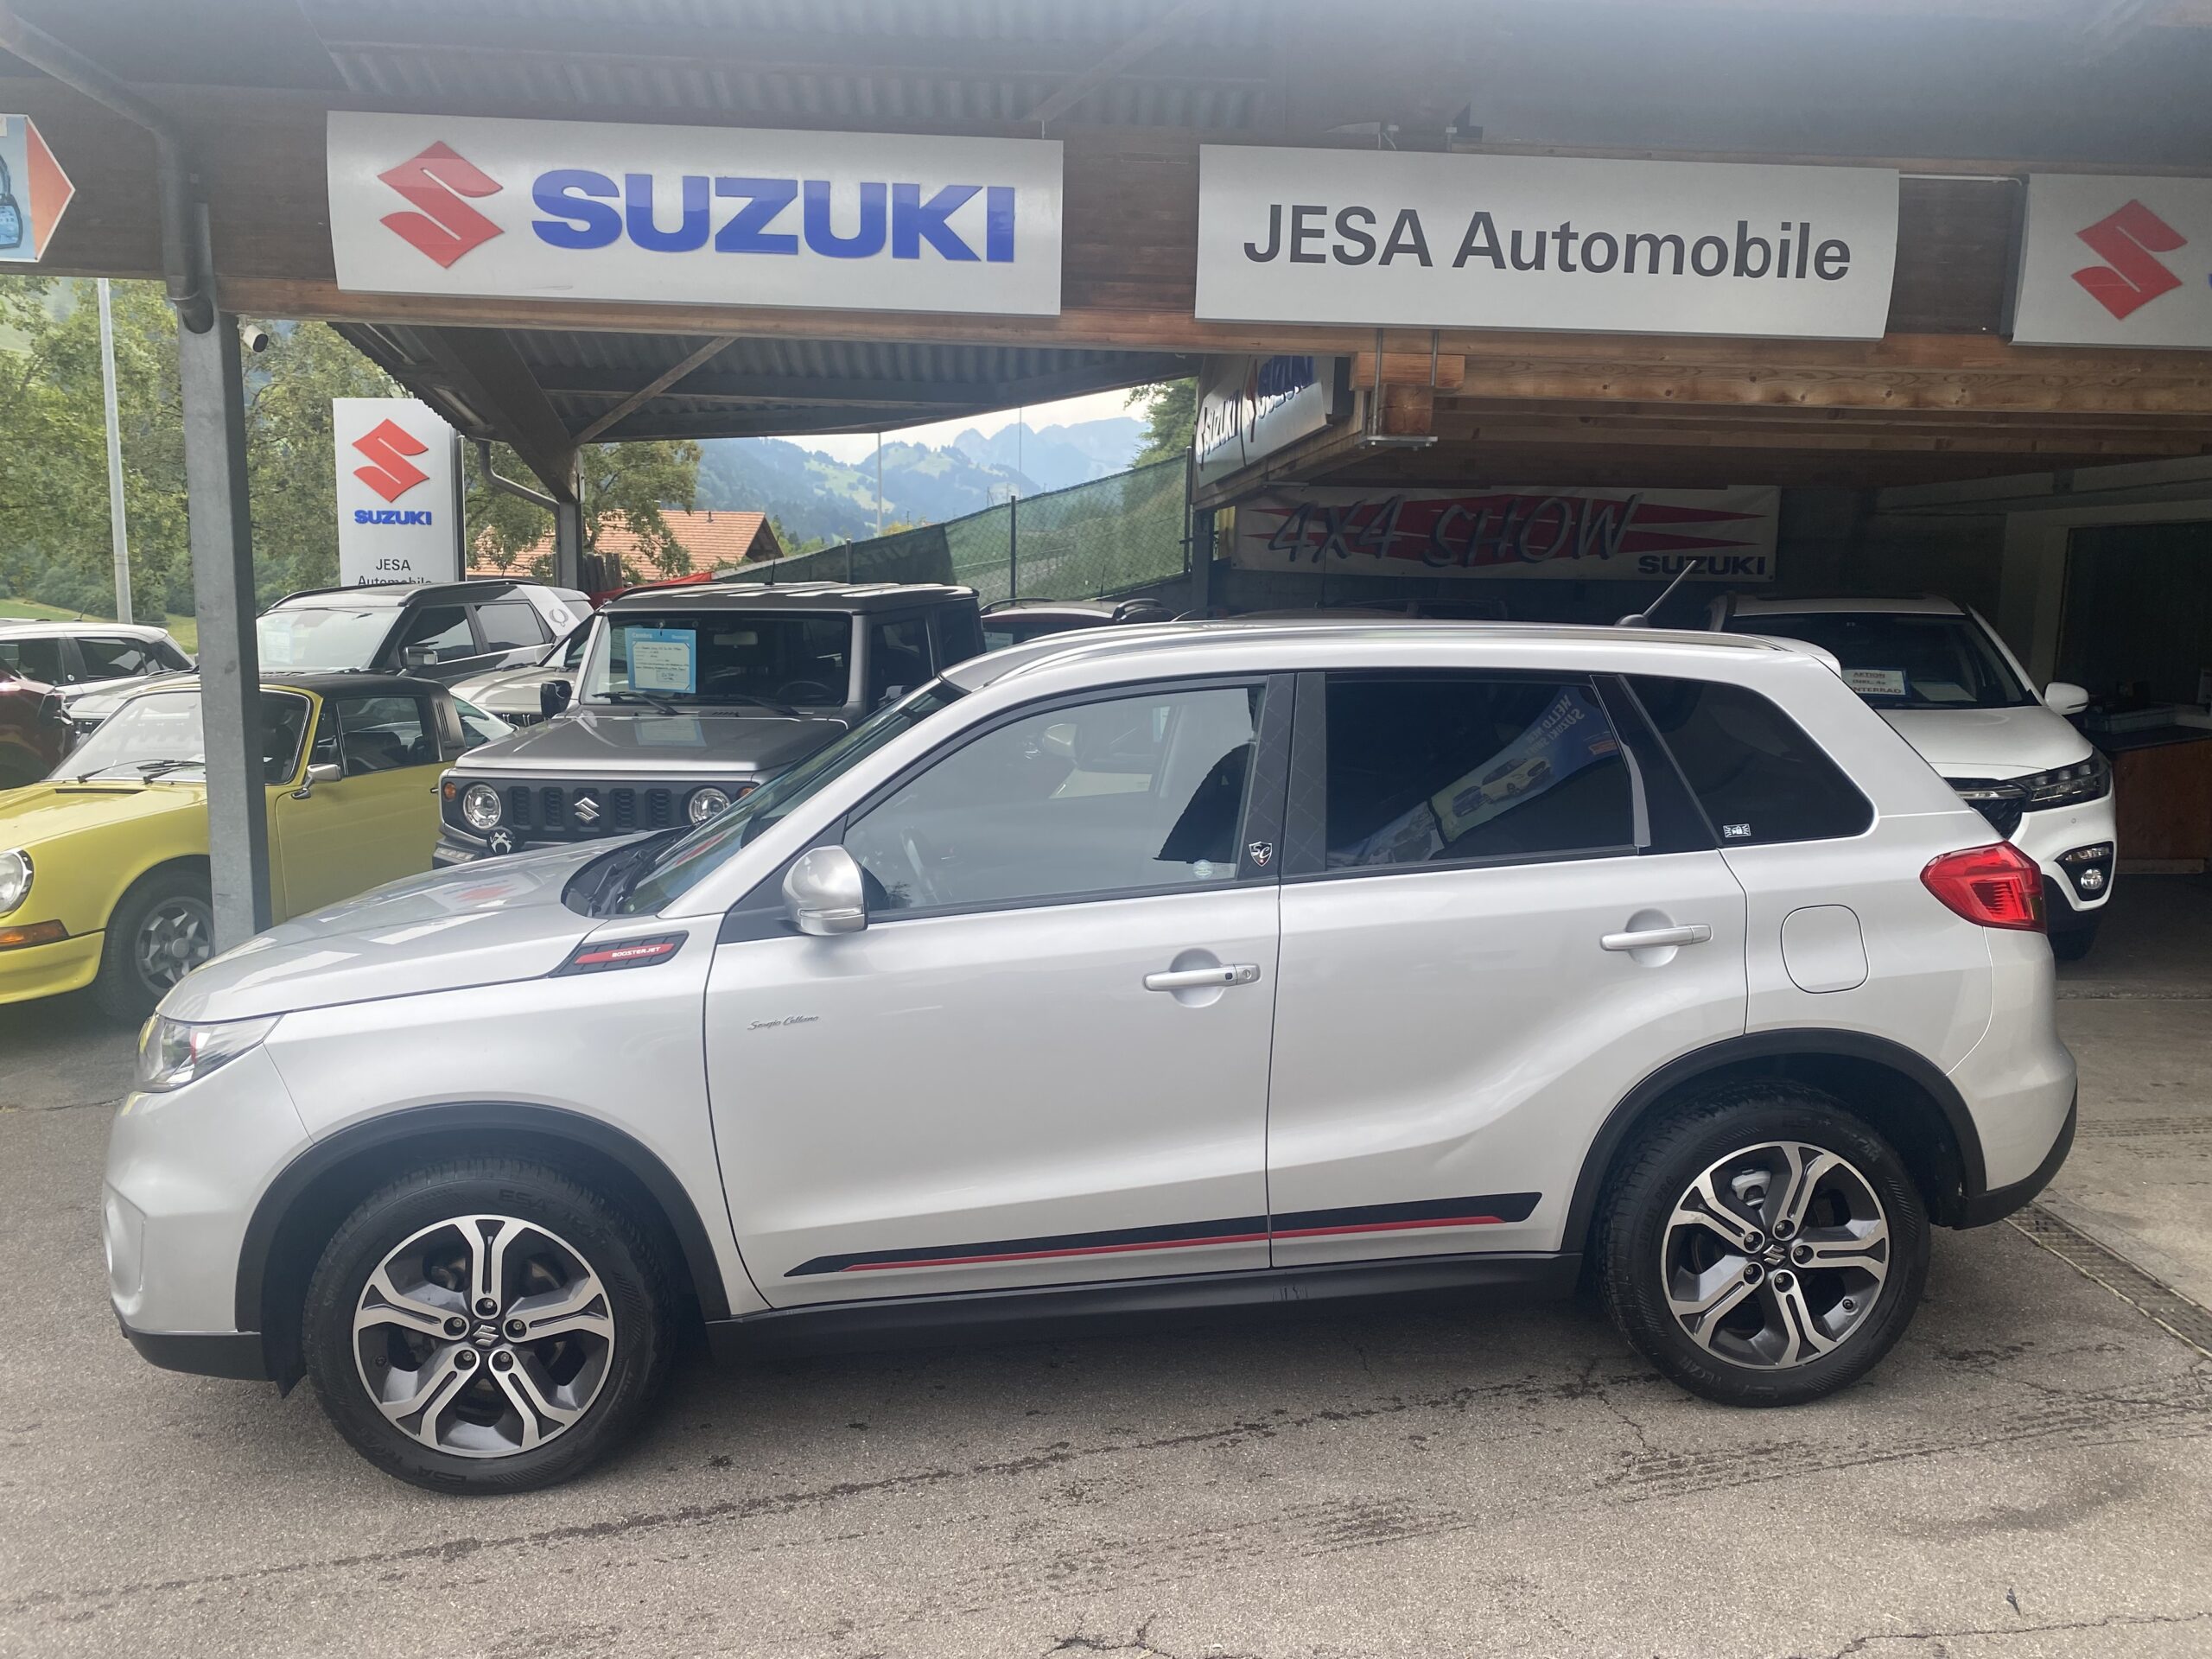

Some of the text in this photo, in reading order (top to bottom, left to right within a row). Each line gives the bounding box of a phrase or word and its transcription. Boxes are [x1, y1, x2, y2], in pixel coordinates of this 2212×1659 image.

[531, 168, 1015, 263] SUZUKI
[1243, 204, 1852, 282] JESA Automobile
[353, 509, 432, 525] SUZUKI
[1422, 492, 1644, 569] SHOW
[376, 558, 411, 571] JESA
[1637, 555, 1766, 575] SUZUKI
[611, 945, 662, 958] BOOSTERJET
